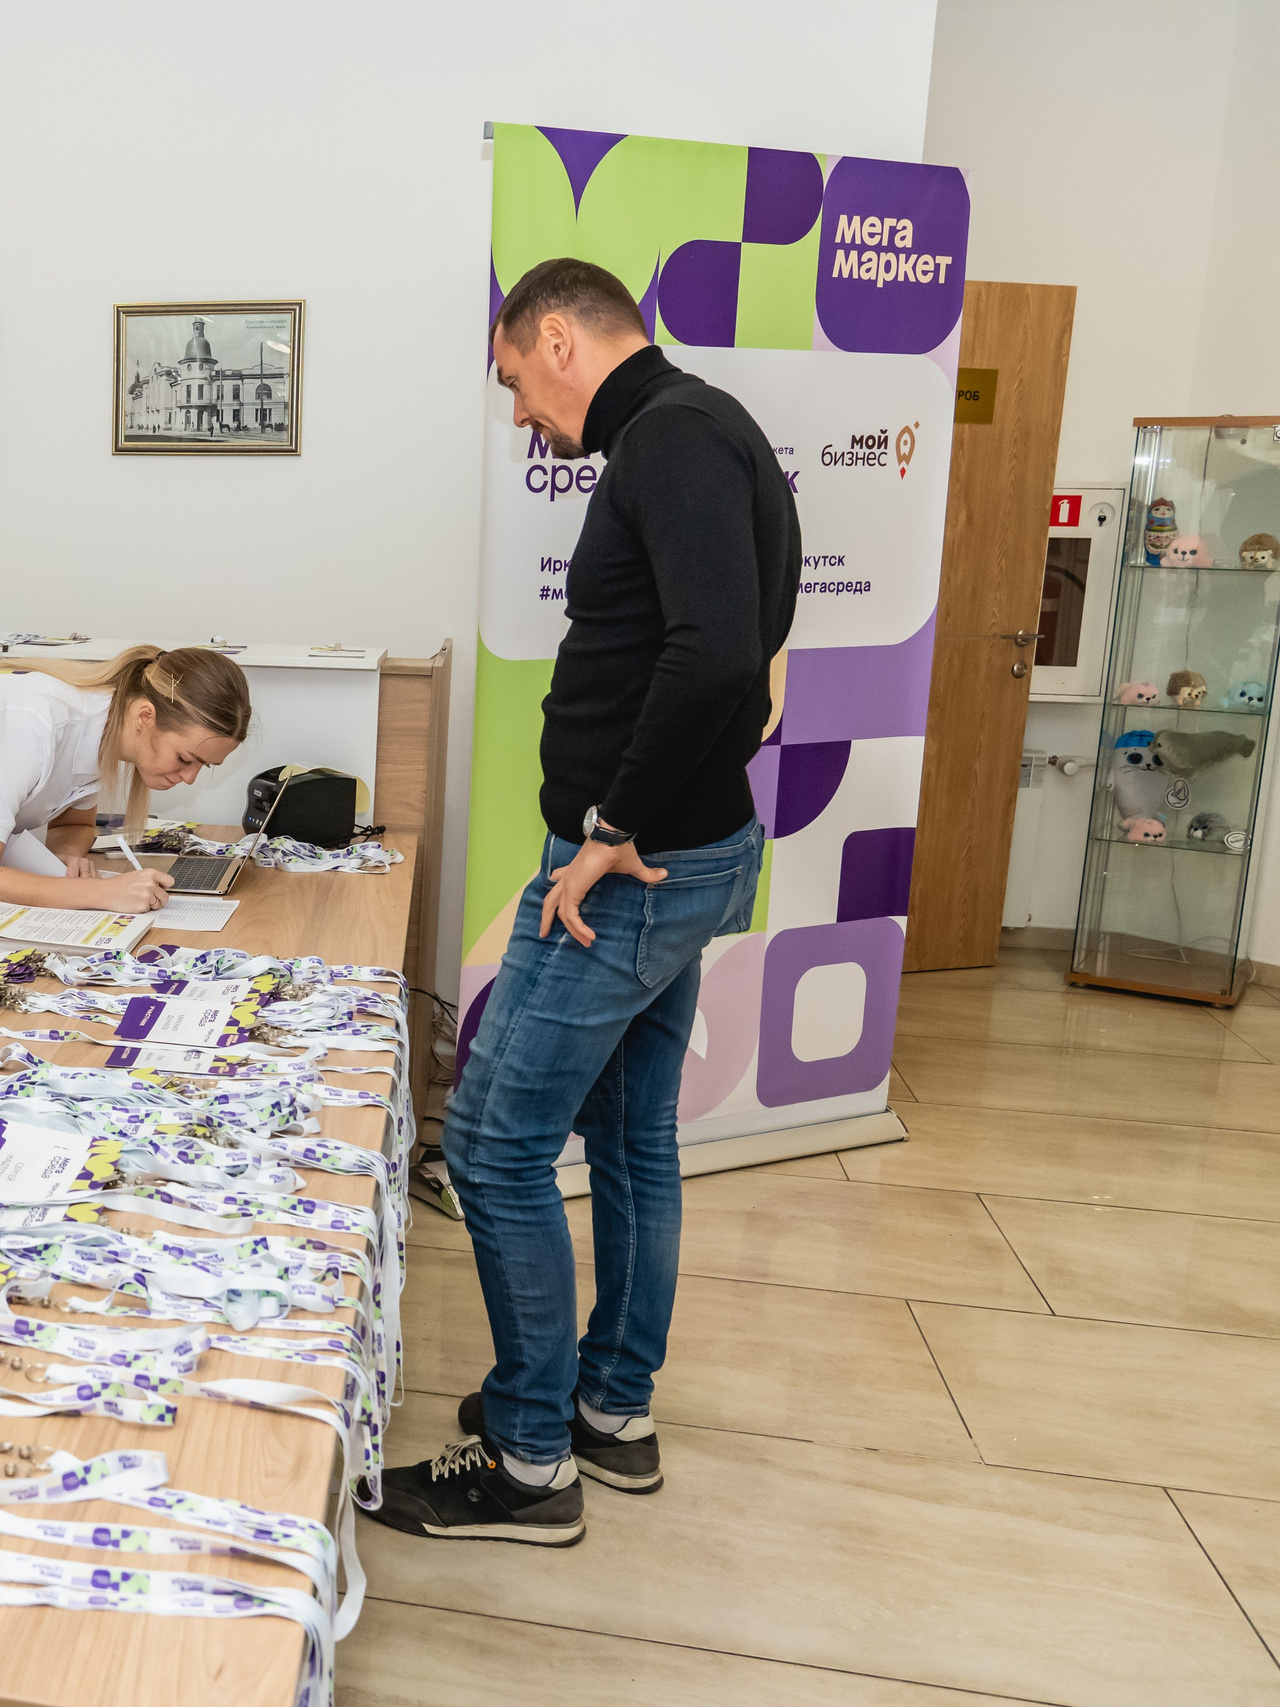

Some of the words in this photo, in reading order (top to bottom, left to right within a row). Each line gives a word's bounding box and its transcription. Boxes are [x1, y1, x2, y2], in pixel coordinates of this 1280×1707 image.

[834, 214, 914, 248] мега
[831, 249, 953, 288] маркет
[851, 431, 889, 450] мой
[821, 444, 888, 467] бизнес
[525, 464, 606, 502] сре
[803, 555, 846, 570] кутск
[797, 580, 871, 596] егасреда
[139, 1005, 156, 1027] УЧАСТНИК
[198, 1009, 213, 1027] среда
[208, 1009, 220, 1023] мега
[41, 1156, 62, 1179] среда
[54, 1157, 71, 1174] мега
